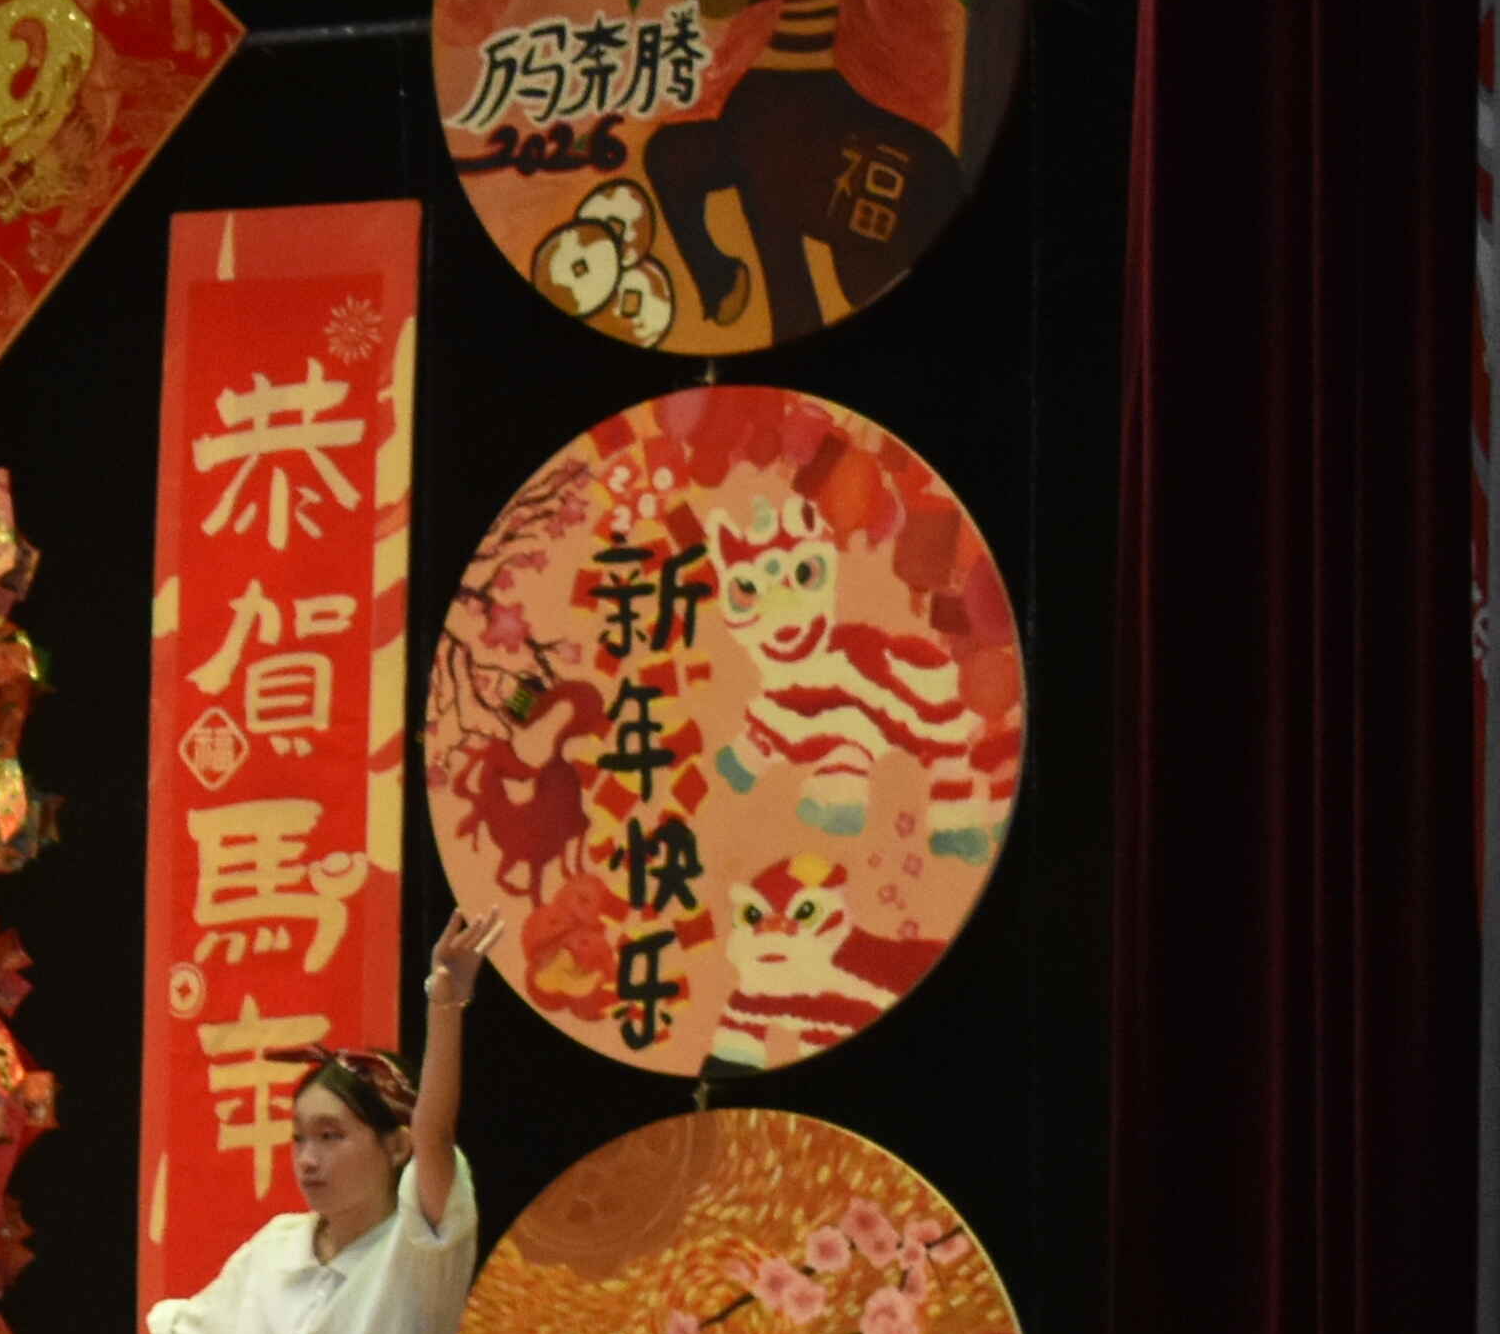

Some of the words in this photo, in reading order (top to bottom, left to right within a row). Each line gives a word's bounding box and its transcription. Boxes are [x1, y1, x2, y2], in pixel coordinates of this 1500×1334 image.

[468, 114, 628, 175] 2026
[830, 138, 911, 244] 福
[186, 358, 367, 1200] 恭賀馬年
[587, 534, 716, 1050] 新年快乐
